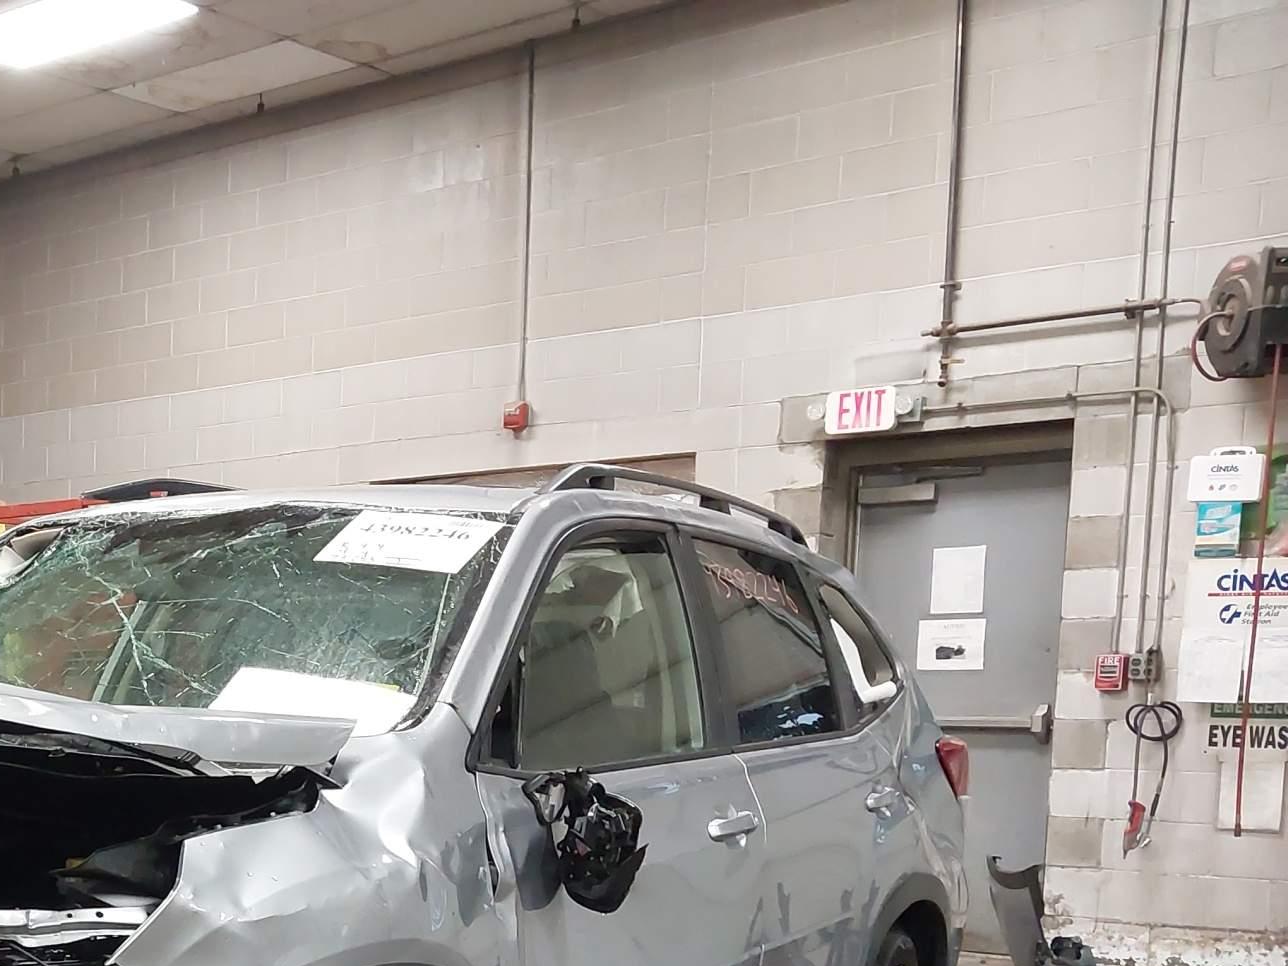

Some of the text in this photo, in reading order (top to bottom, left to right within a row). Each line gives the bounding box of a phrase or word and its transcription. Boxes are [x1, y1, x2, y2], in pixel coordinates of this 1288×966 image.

[837, 390, 886, 430] EXIT
[1264, 609, 1280, 617] Aid
[1098, 656, 1120, 666] FIRE
[1208, 725, 1246, 748] EYE
